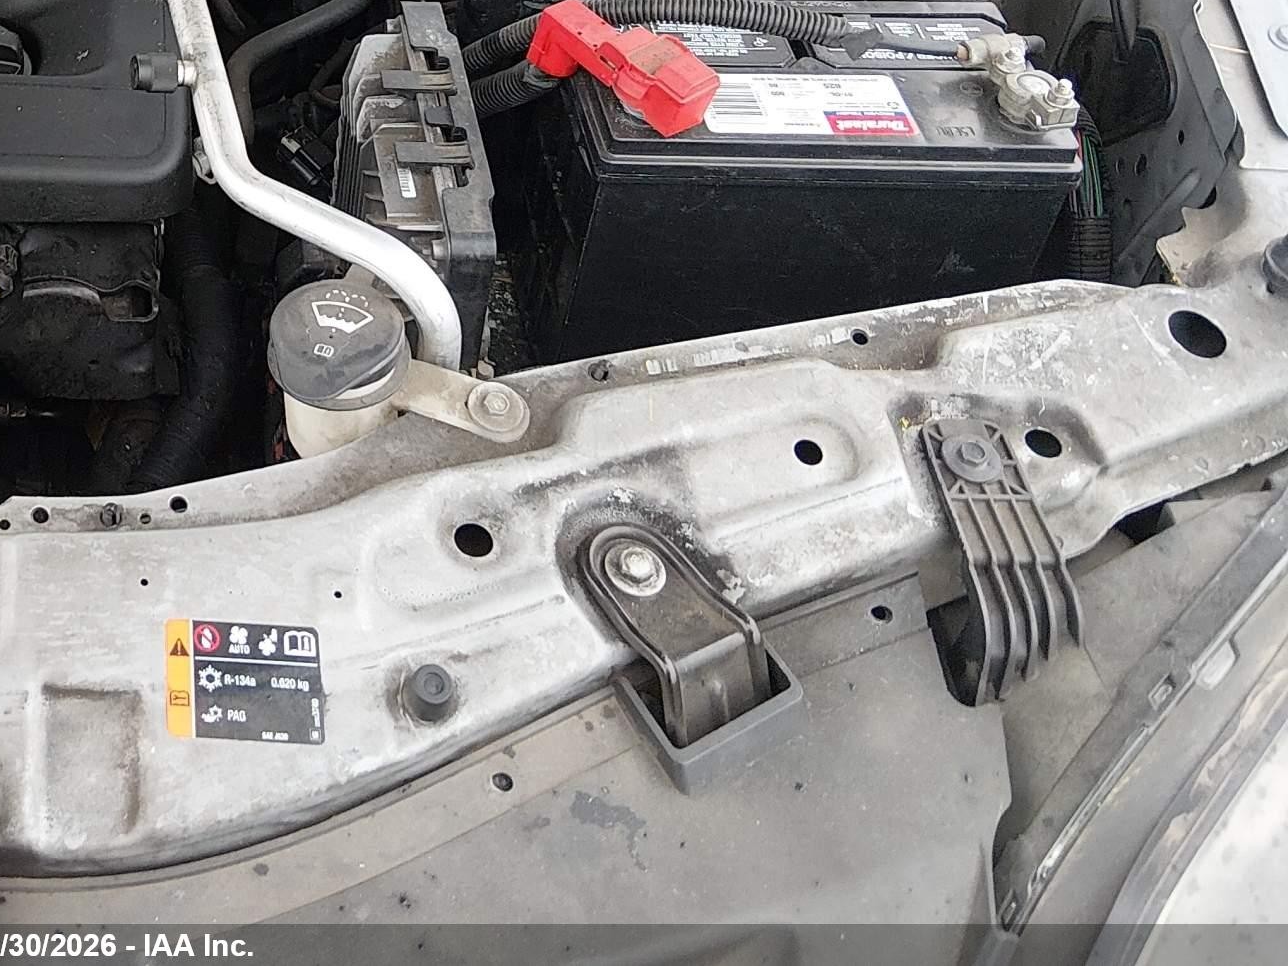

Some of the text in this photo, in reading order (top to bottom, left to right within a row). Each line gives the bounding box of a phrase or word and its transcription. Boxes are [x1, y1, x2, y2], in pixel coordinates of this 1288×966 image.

[836, 120, 910, 131] Duralast
[229, 644, 250, 655] AUTO
[224, 673, 310, 691] R-134a 0.620 kg
[227, 709, 247, 722] PAG
